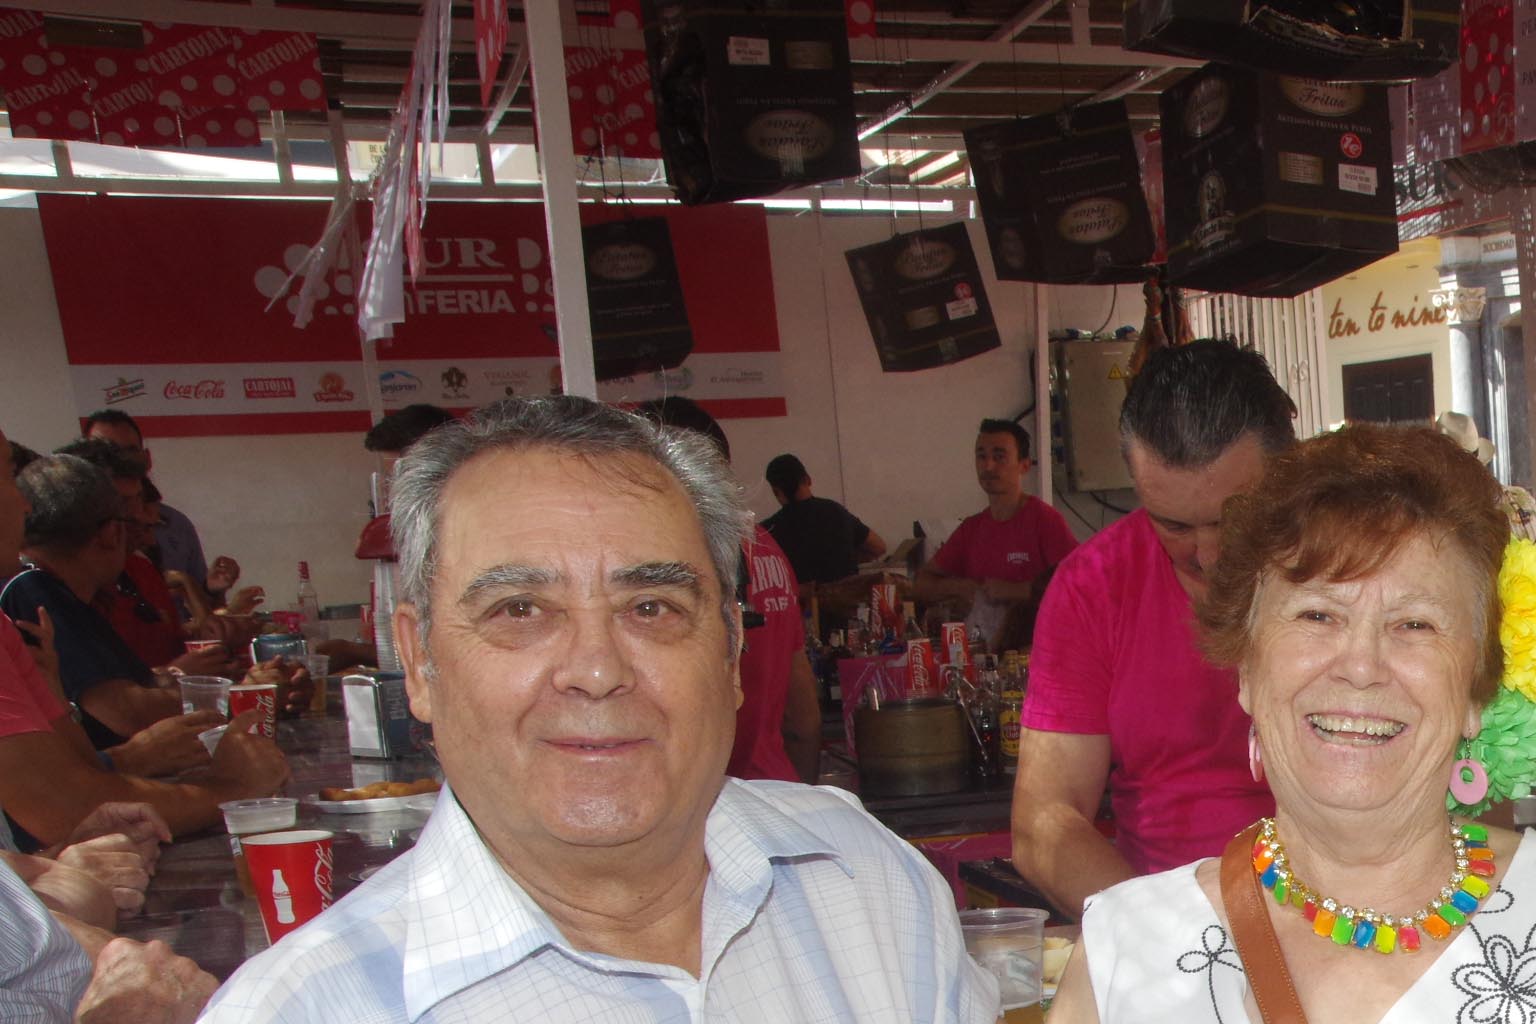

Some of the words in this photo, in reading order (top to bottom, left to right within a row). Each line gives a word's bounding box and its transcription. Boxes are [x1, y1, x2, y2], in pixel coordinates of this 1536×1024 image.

[151, 27, 234, 75] CARTOJAL
[238, 32, 320, 80] CARTOJAL
[1328, 297, 1361, 339] ten
[1367, 290, 1388, 332] to
